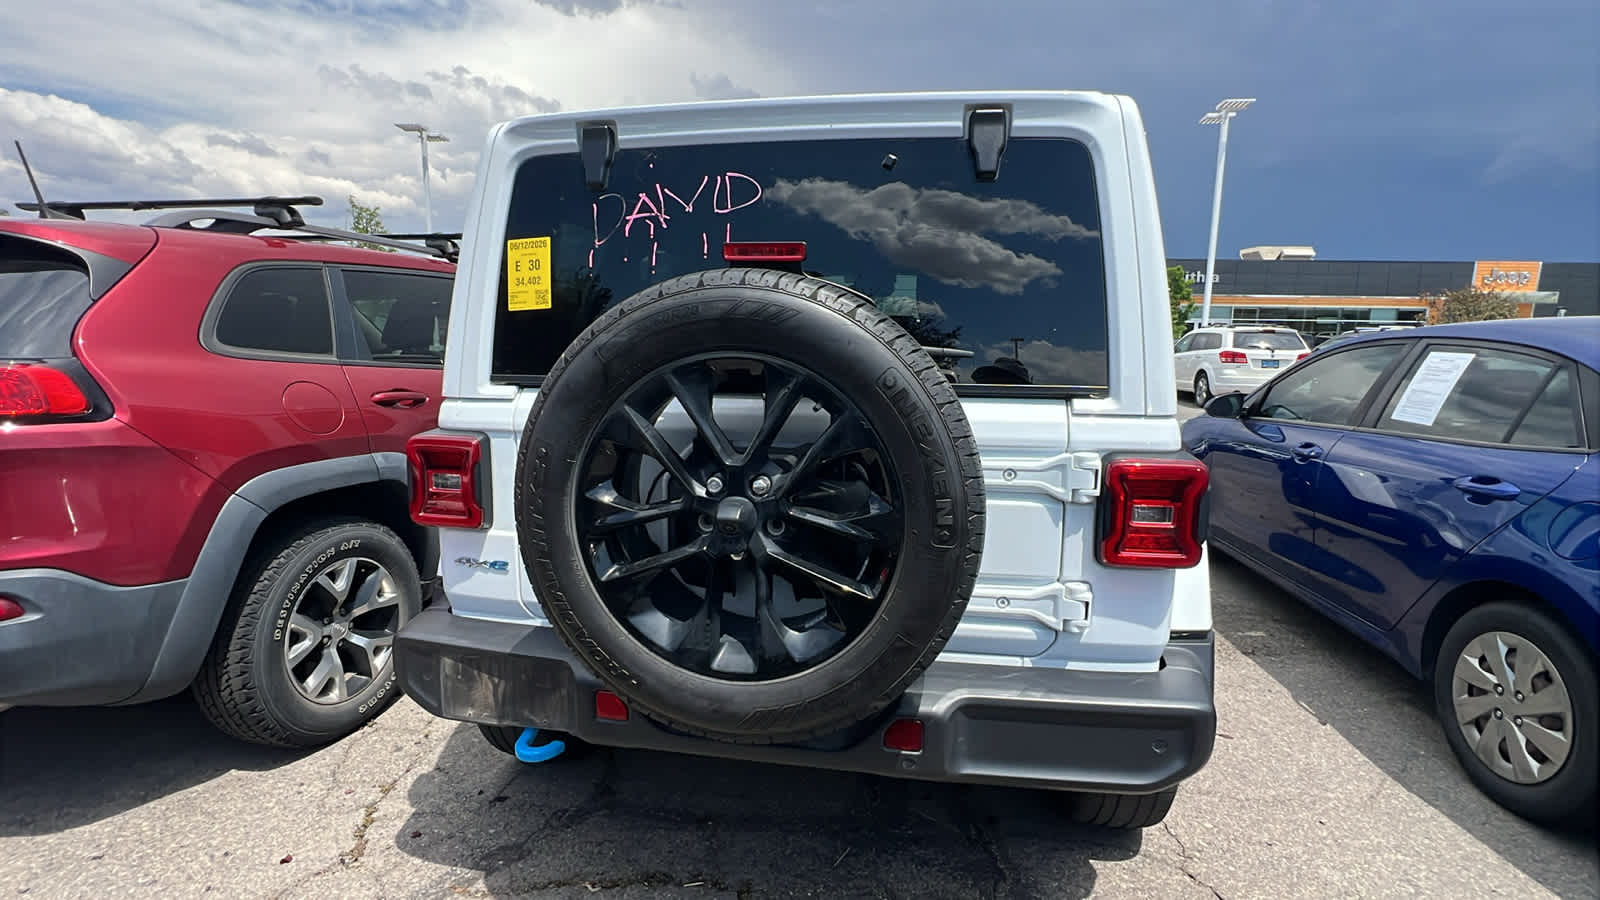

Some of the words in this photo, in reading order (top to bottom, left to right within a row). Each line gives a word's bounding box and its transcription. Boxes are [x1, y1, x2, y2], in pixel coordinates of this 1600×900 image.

[593, 172, 762, 249] DAVID
[515, 260, 521, 272] E
[528, 258, 541, 272] 30
[1185, 270, 1220, 283] itha
[1483, 268, 1531, 287] Jeep
